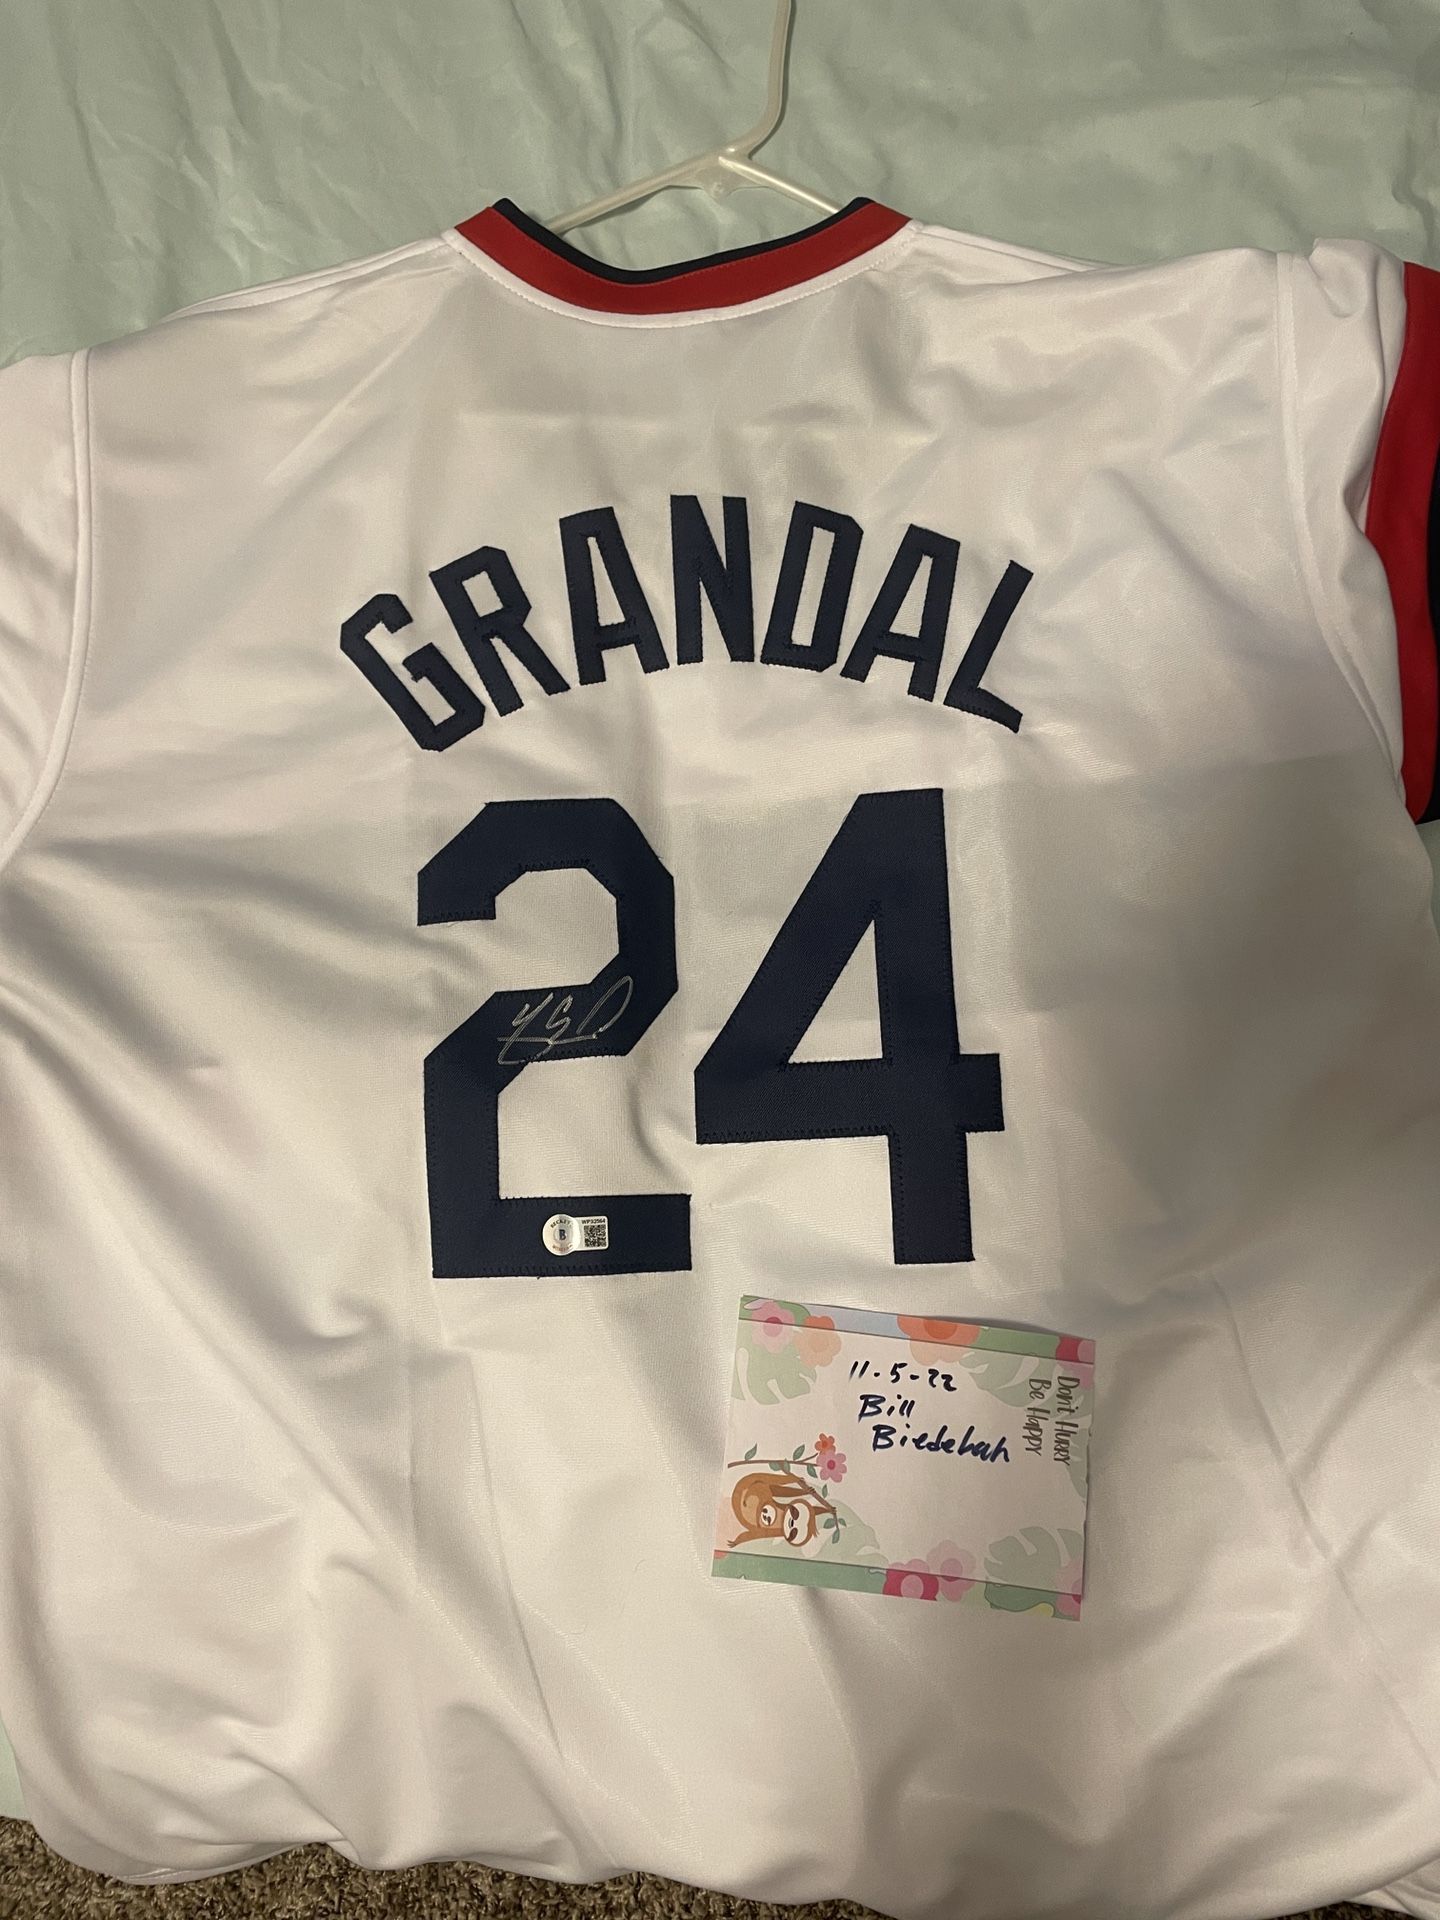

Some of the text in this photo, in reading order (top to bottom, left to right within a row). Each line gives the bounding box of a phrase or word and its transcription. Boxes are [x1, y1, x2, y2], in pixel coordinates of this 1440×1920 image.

[340, 494, 1034, 751] GRANDAL
[417, 788, 1005, 1278] 24
[858, 1394, 915, 1422] Bill
[1028, 1379, 1052, 1400] Be
